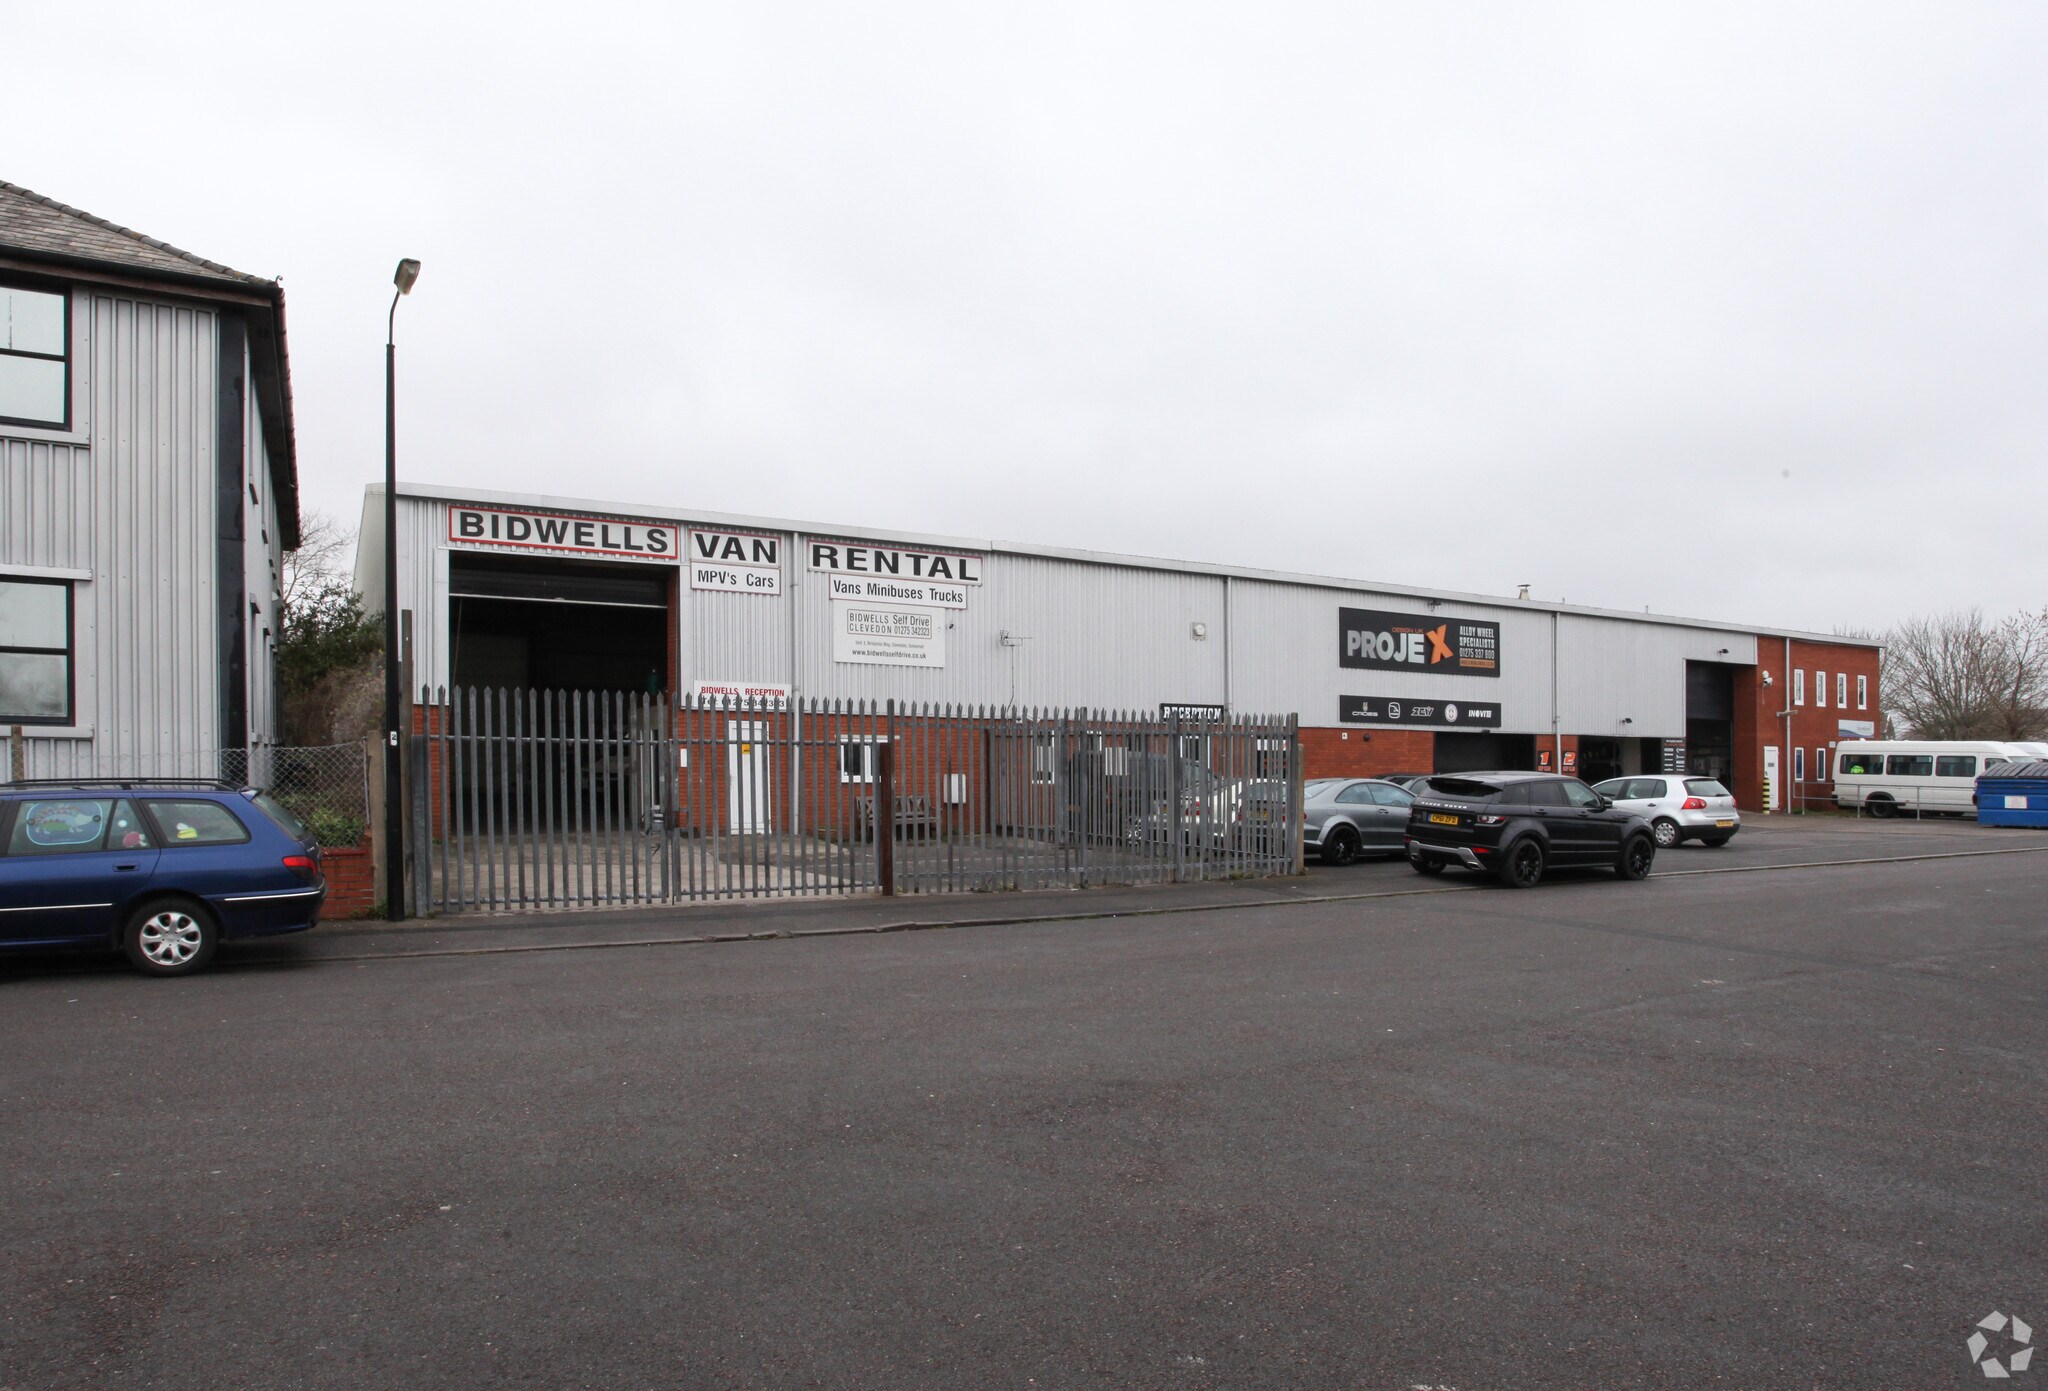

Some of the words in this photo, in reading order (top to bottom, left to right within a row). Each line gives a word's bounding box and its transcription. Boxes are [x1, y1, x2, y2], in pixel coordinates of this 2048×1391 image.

[459, 511, 668, 553] BIDWELLS
[695, 533, 777, 563] VAN
[812, 544, 979, 581] RENTAL
[698, 569, 737, 585] MPV's
[746, 573, 774, 588] Cars
[833, 580, 861, 594] Vans
[867, 583, 923, 599] Minibuses
[929, 588, 963, 603] Trucks
[849, 612, 889, 624] BIDWELLS
[892, 614, 908, 625] Self
[910, 615, 930, 627] Drive
[849, 623, 892, 634] CLEVEDON
[1460, 625, 1476, 637] ALLOY
[1477, 627, 1494, 638] WHEEL
[1347, 624, 1454, 665] PROJEX
[1460, 636, 1495, 649] SPECIALISTS
[852, 649, 927, 659] www.bidwellsselfdrive.co.uk
[701, 686, 740, 695] BIDWELLS
[745, 688, 785, 697] RECEPTION
[1540, 751, 1550, 766] 1
[1562, 751, 1576, 766] 2
